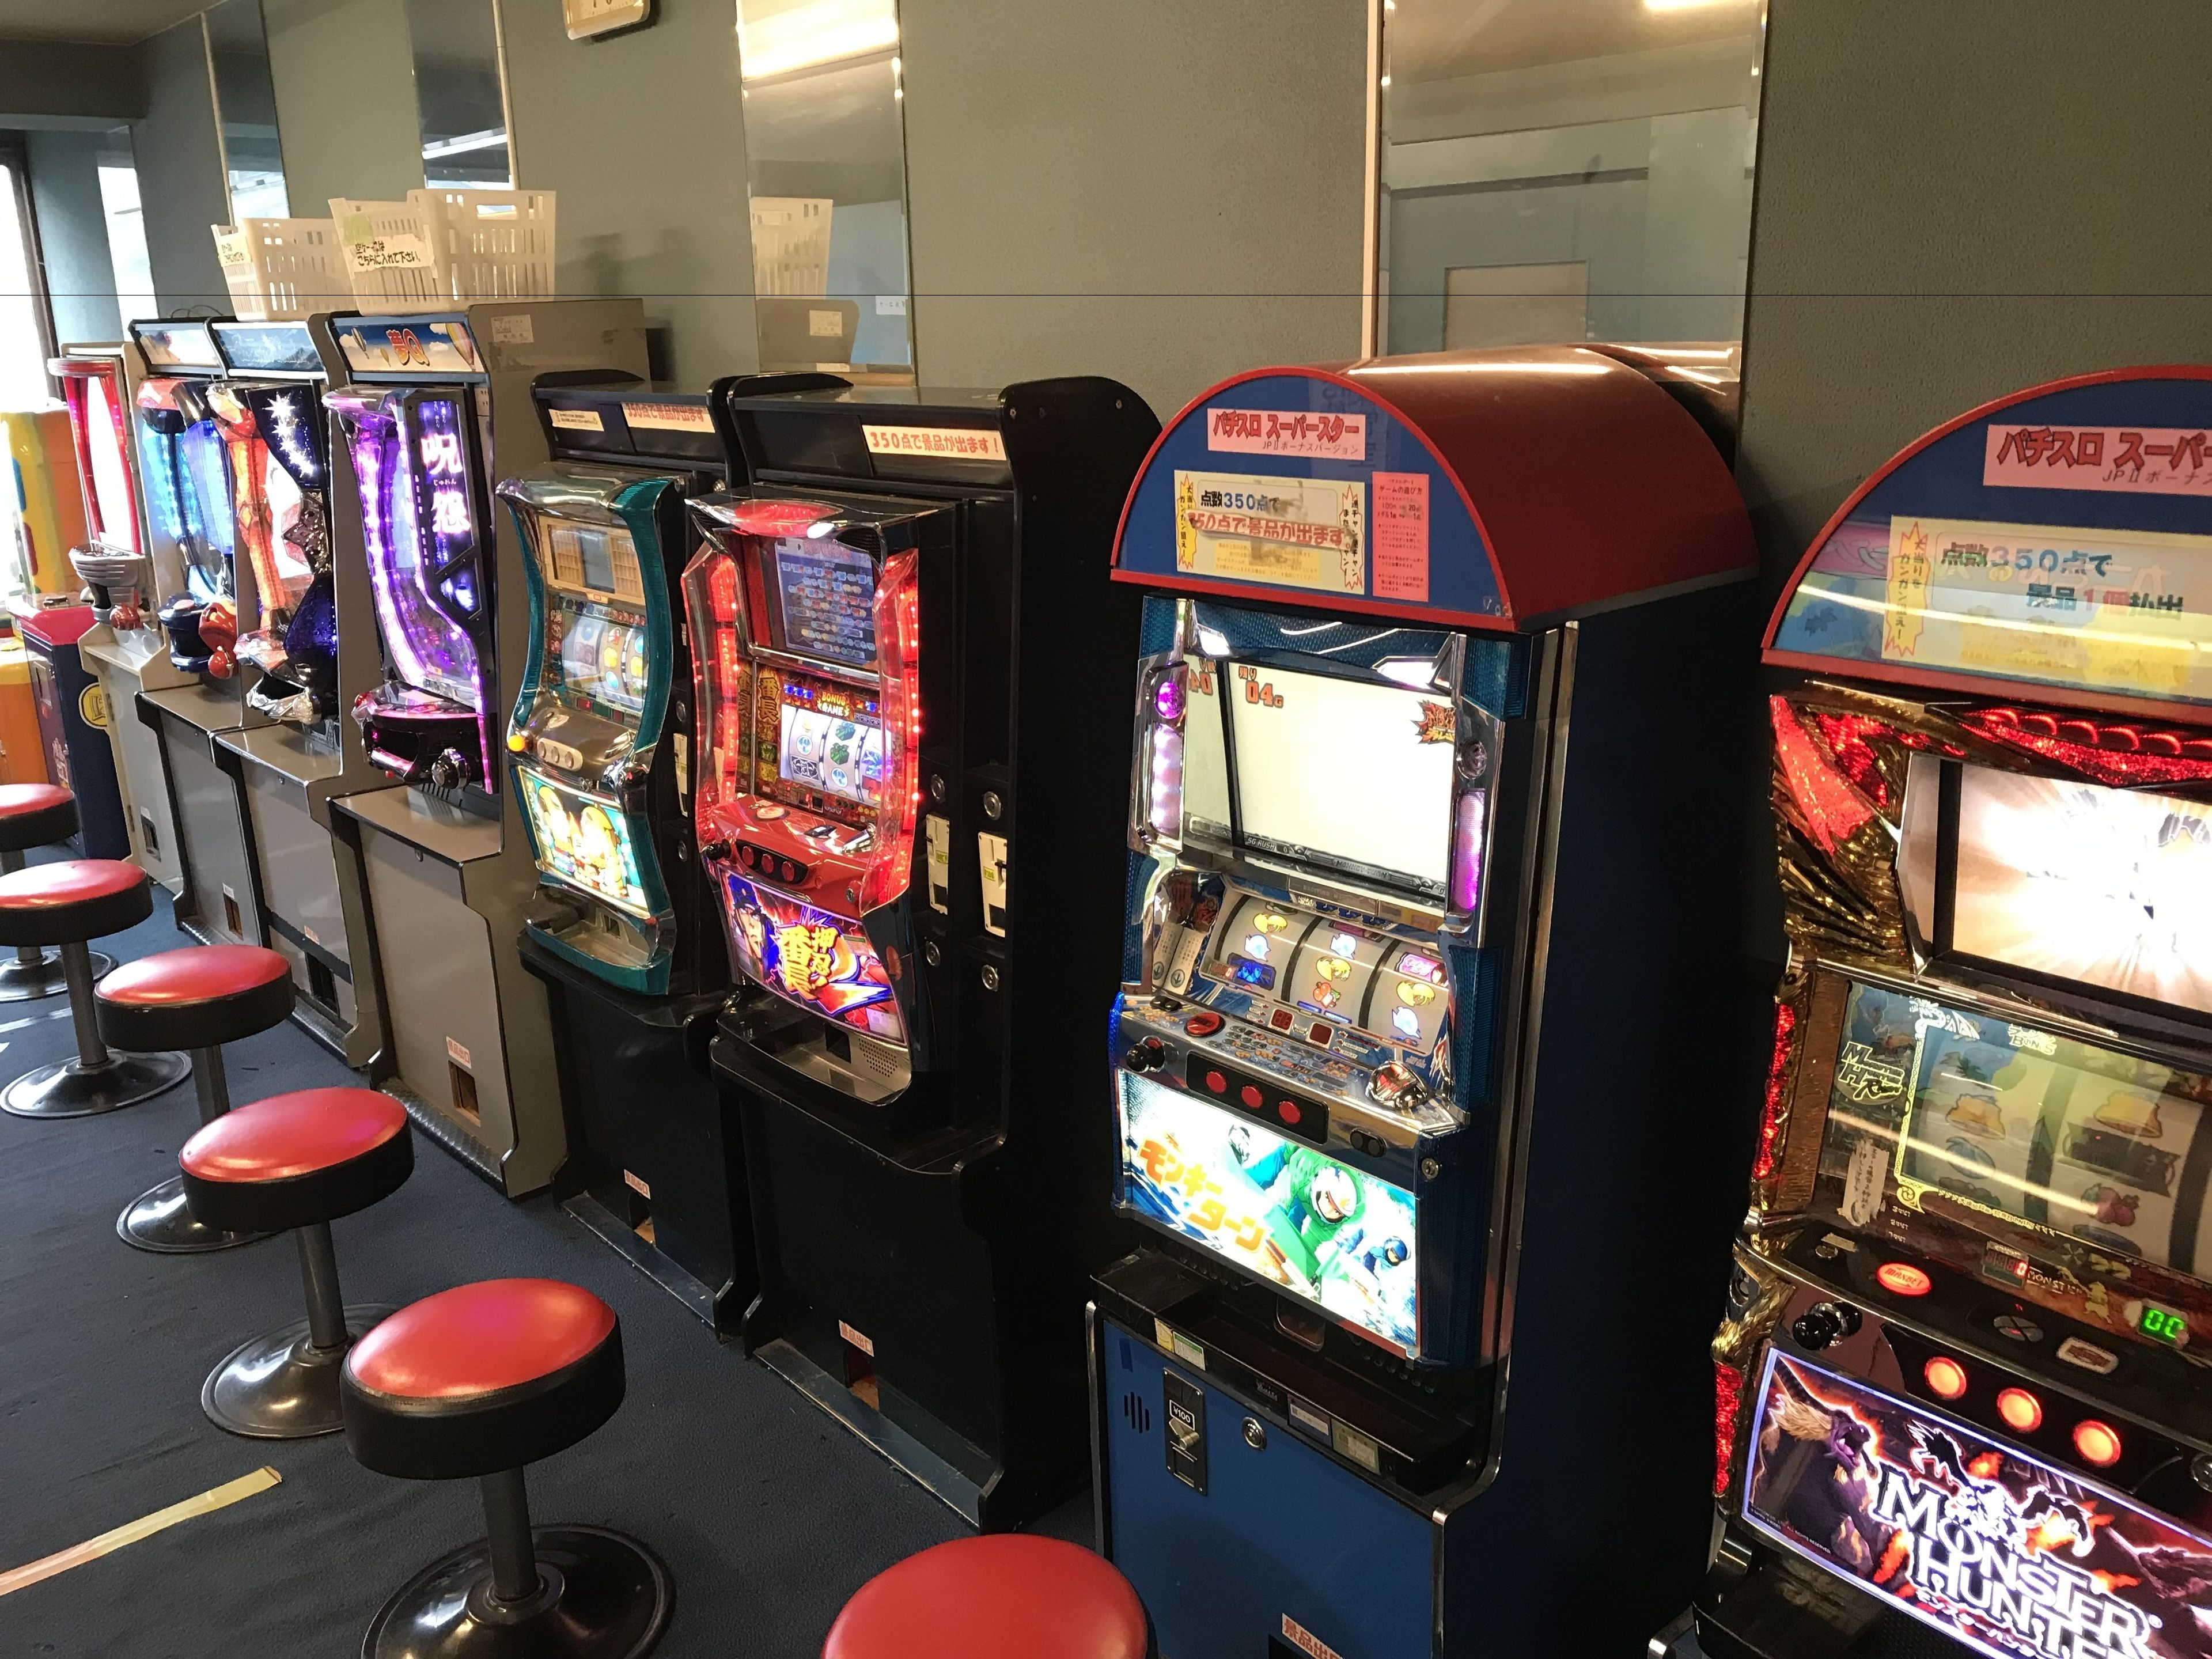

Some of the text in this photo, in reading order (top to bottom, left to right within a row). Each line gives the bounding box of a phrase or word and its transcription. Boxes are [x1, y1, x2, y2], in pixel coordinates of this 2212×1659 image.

[1213, 410, 1359, 444] パチスロ スーパースター
[1997, 427, 2212, 471] パチスロ スーパ
[1200, 490, 1280, 512] 点数350点で
[821, 691, 847, 706] BONUS
[1257, 840, 1275, 851] RUSH
[1173, 1404, 1191, 1424] ¥100
